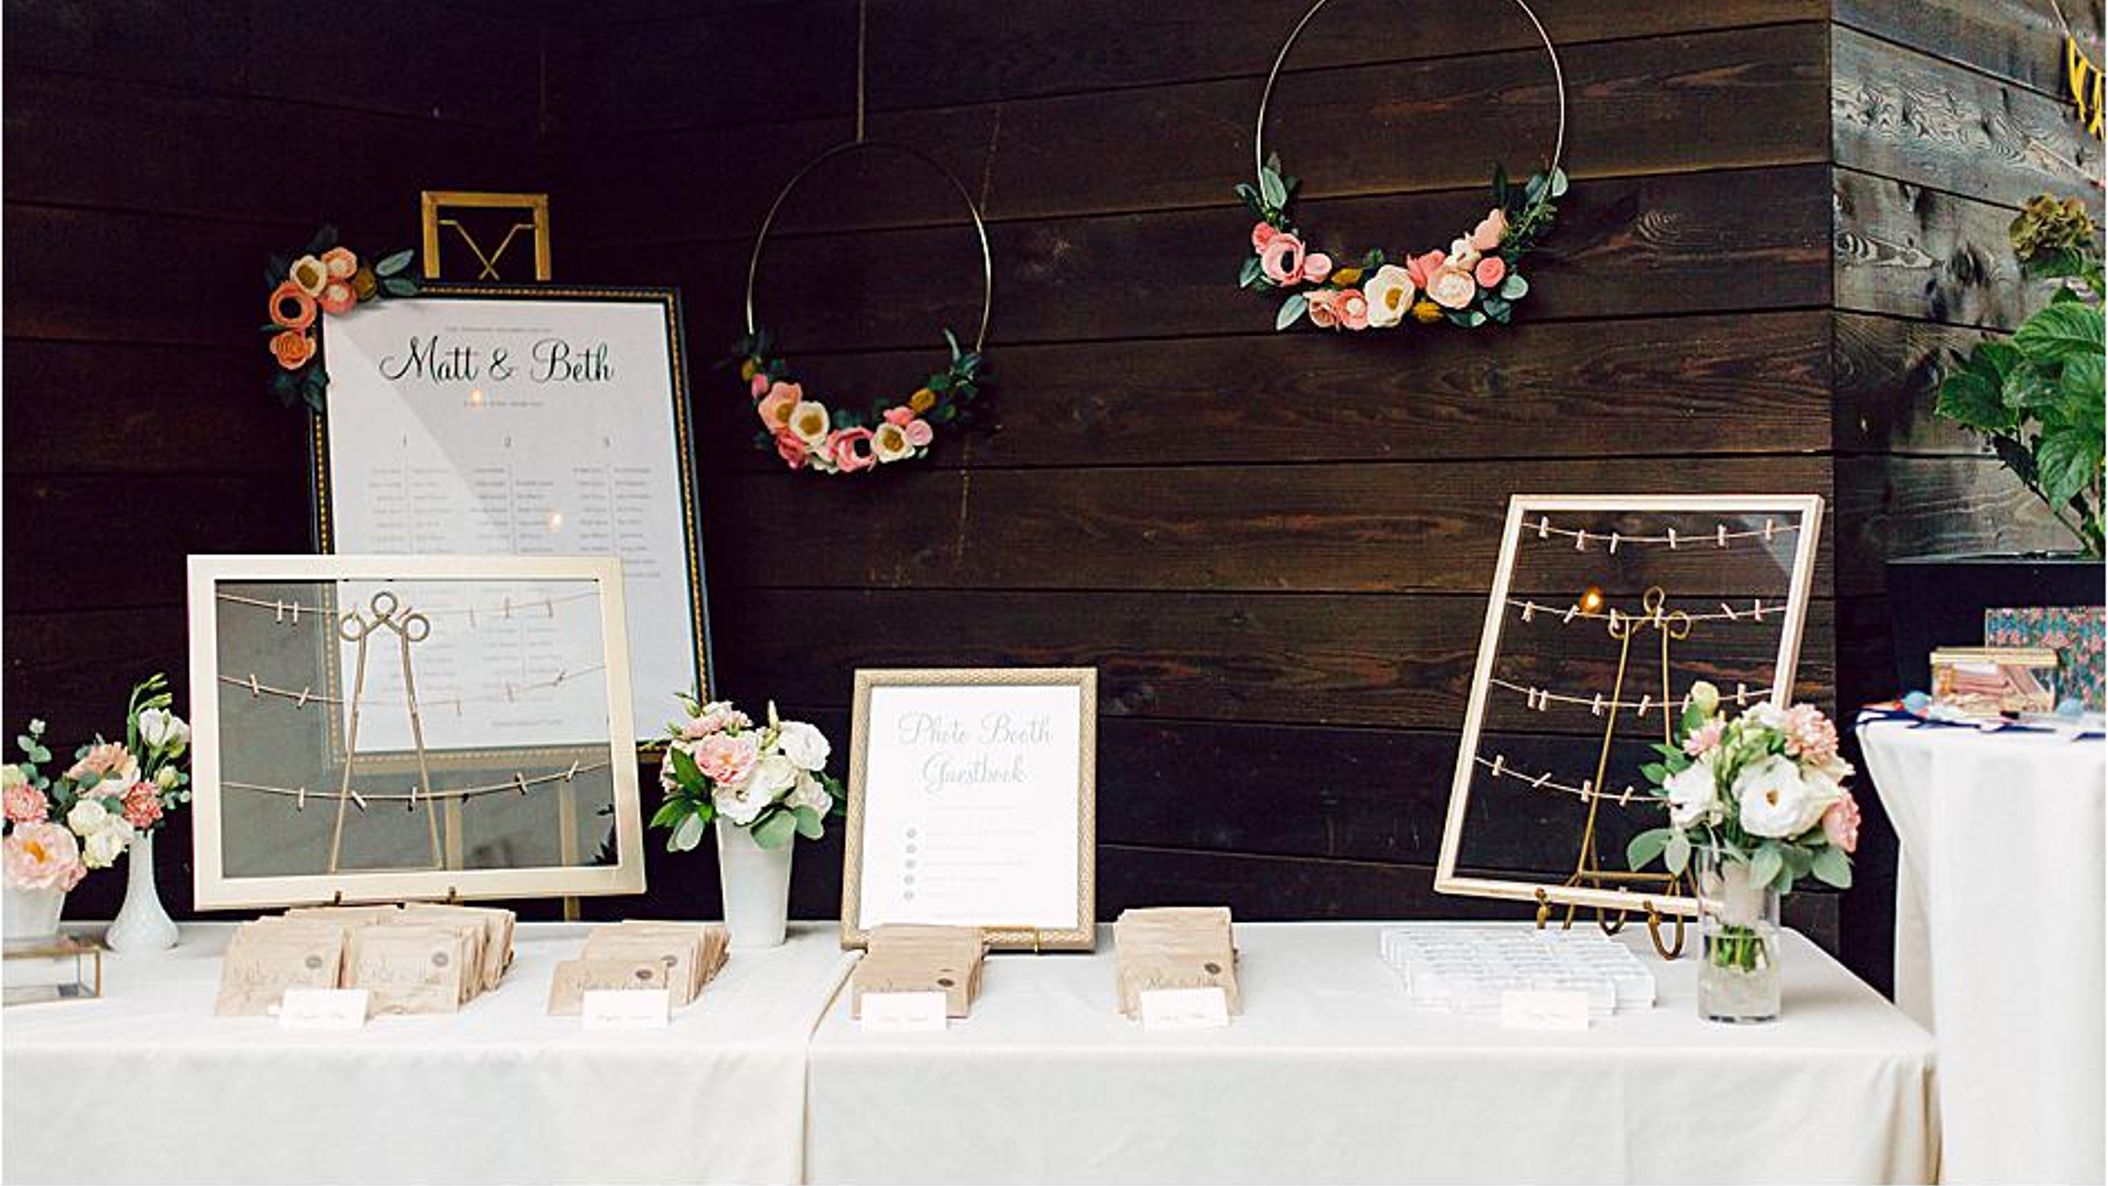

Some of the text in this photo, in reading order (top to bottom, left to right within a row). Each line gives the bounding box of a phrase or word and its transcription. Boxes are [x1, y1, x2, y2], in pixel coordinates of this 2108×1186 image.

[379, 335, 615, 385] Matt & Beth
[897, 710, 1054, 746] Photo Booth
[922, 751, 1029, 794] Guestbook
